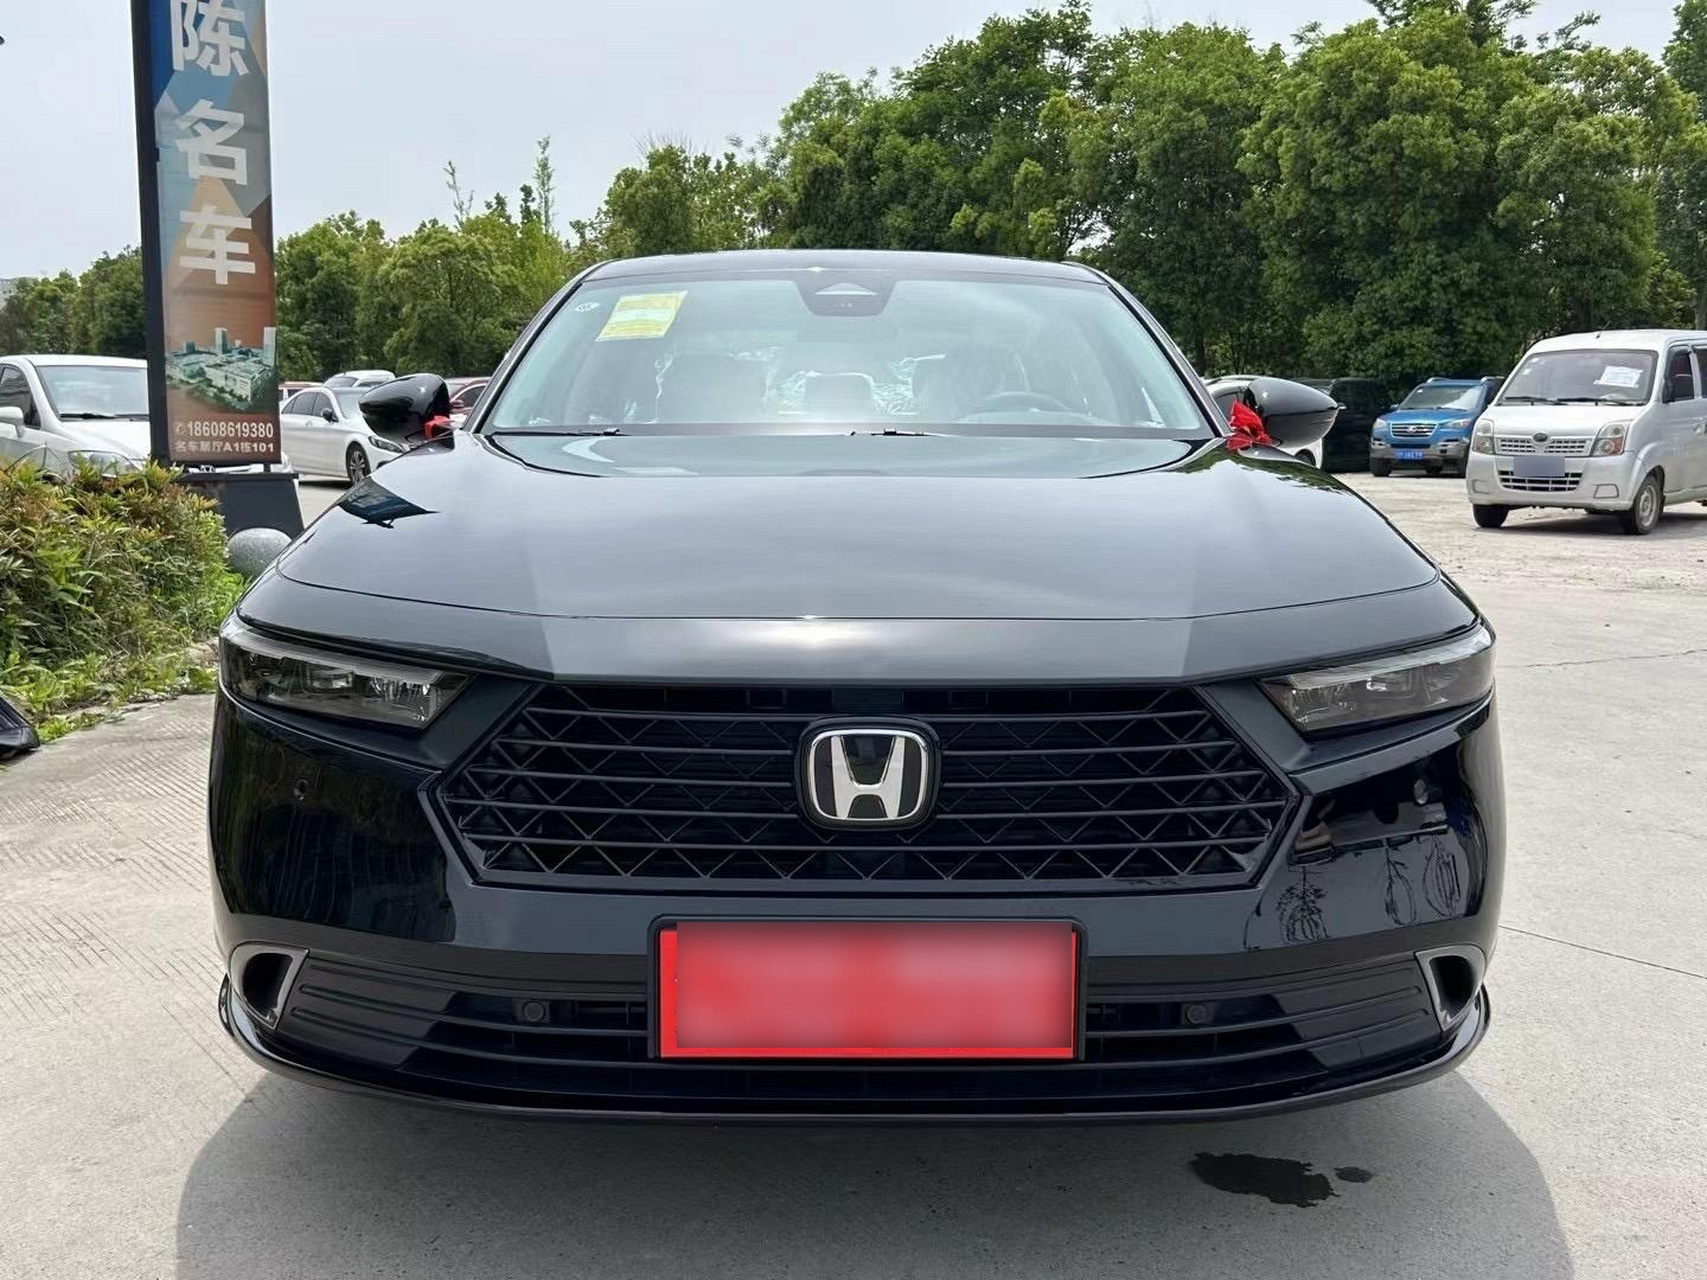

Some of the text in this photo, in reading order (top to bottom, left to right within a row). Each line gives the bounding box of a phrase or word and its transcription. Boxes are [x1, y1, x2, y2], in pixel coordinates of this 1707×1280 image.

[170, 0, 256, 286] 陈名车
[188, 421, 274, 438] 18608619380
